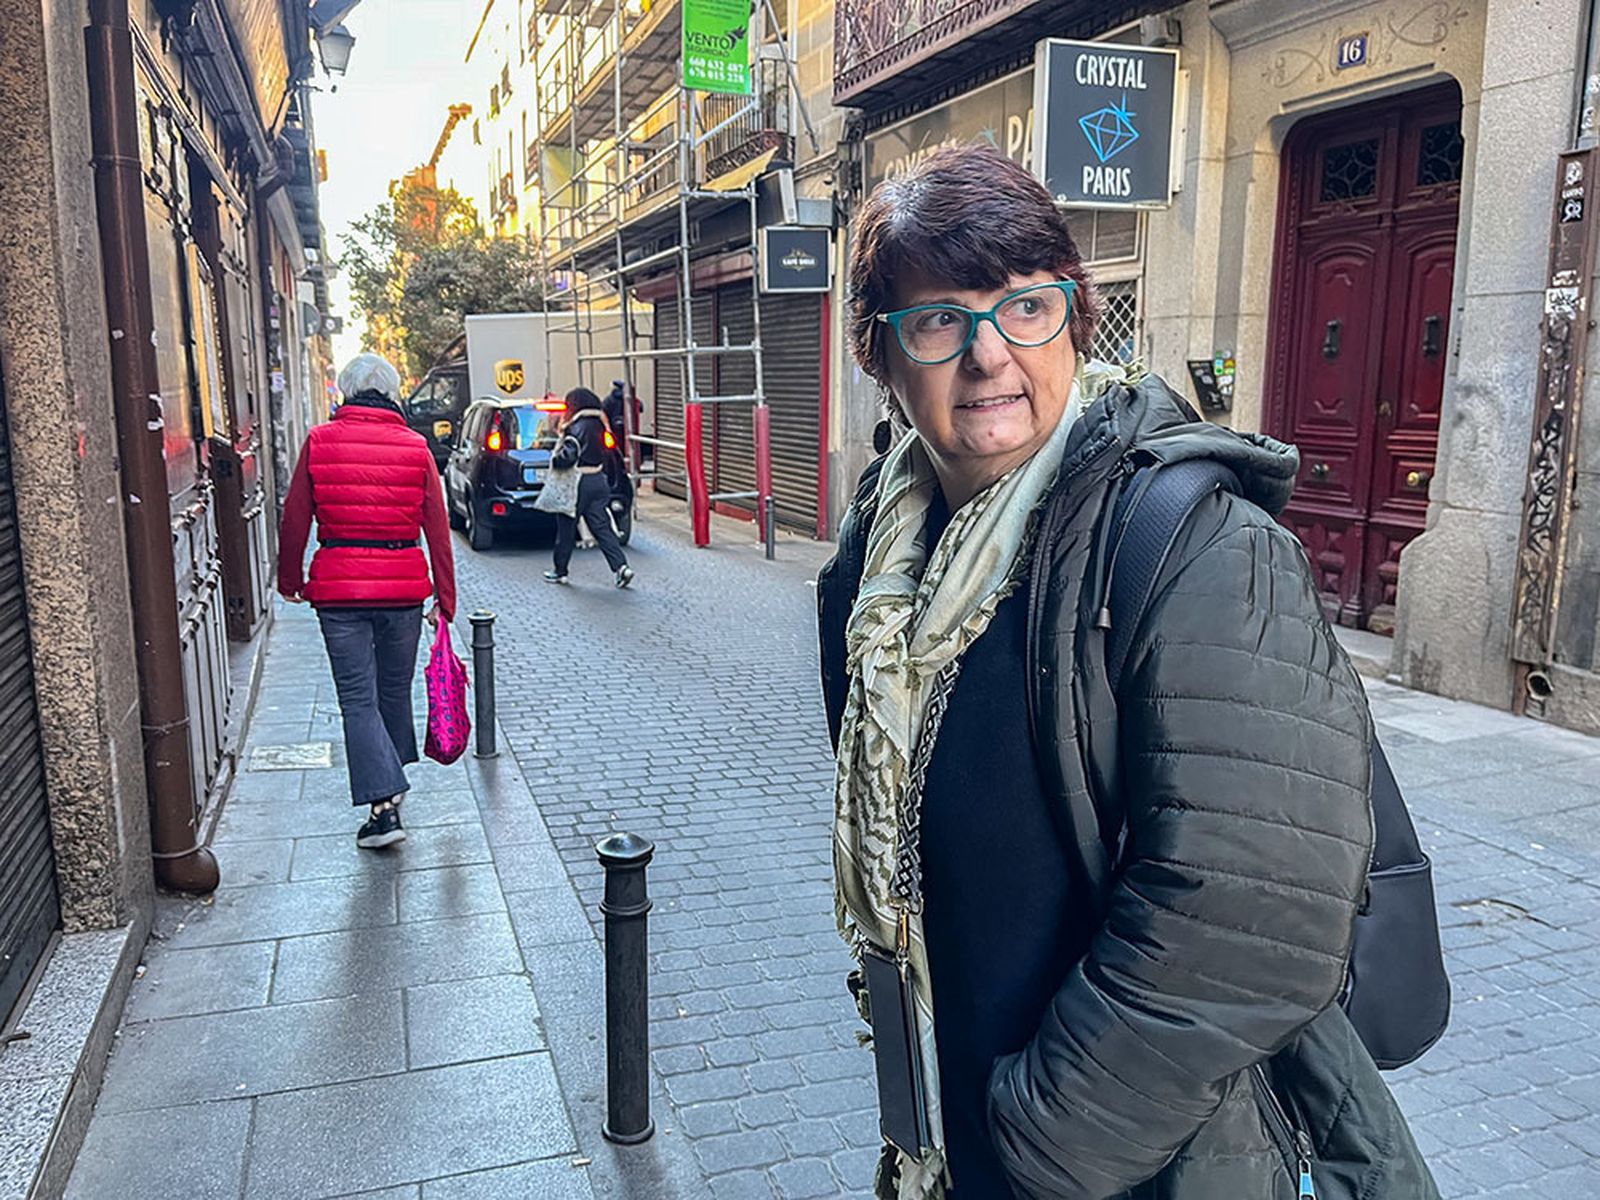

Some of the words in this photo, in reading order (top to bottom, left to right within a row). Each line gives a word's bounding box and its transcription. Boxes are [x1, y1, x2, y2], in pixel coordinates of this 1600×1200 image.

[685, 30, 730, 50] VENTO
[1342, 39, 1361, 63] 16
[1075, 53, 1147, 89] CRYSTAL
[1082, 165, 1131, 197] PARIS
[496, 369, 524, 391] ups
